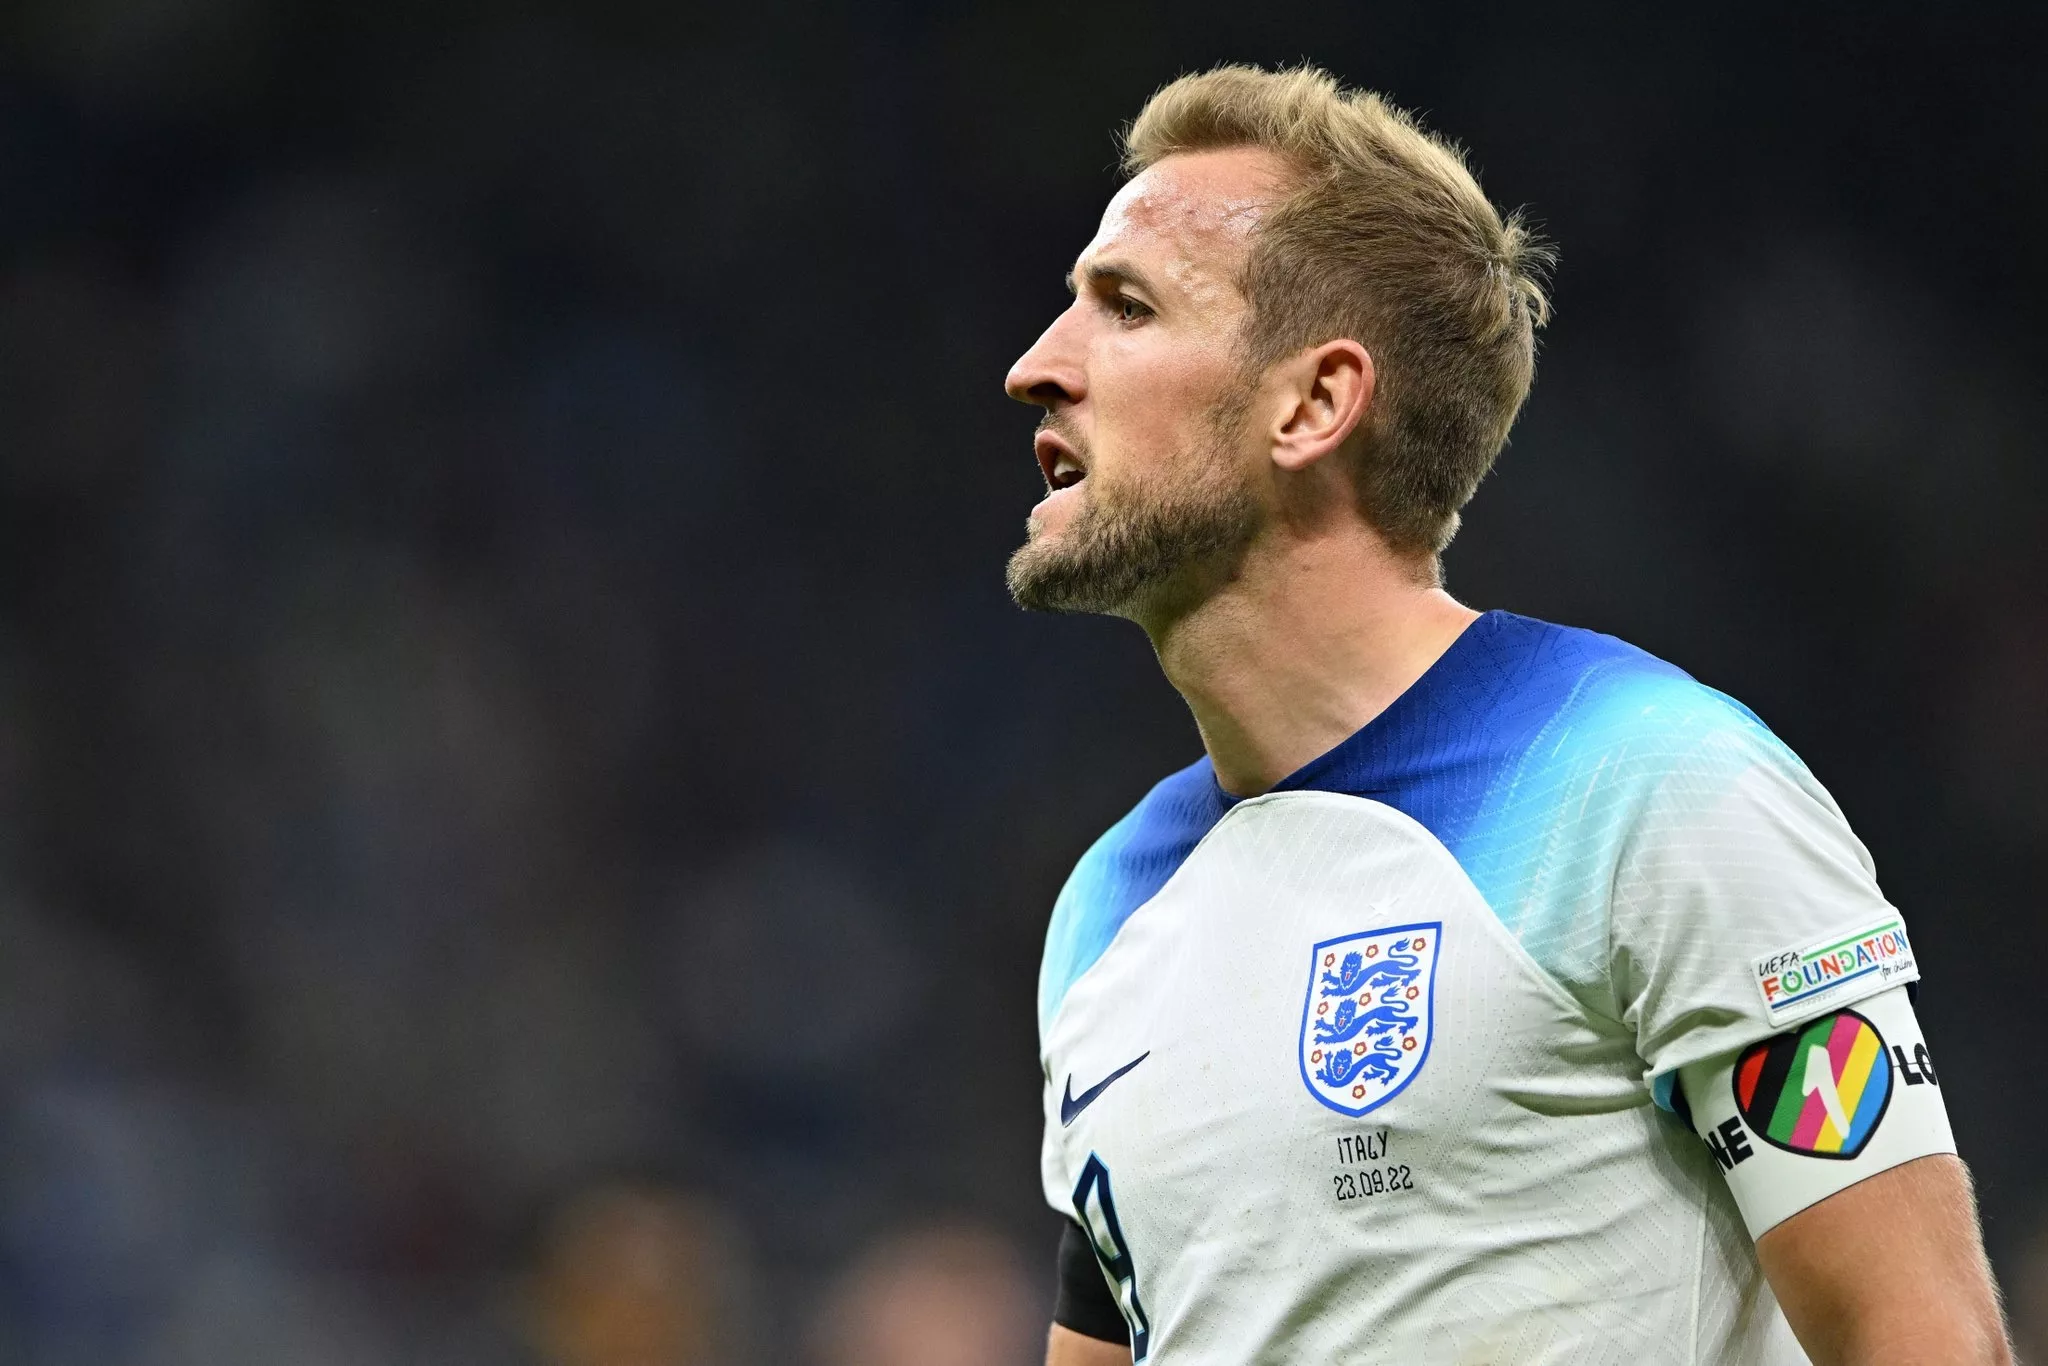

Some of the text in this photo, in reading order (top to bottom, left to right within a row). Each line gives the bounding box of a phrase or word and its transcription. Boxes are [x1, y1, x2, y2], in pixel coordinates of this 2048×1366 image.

[1759, 952, 1800, 977] UEFA
[1802, 1044, 1850, 1139] 1
[1337, 1131, 1388, 1164] ITALY
[1333, 1164, 1414, 1201] 23.09.22
